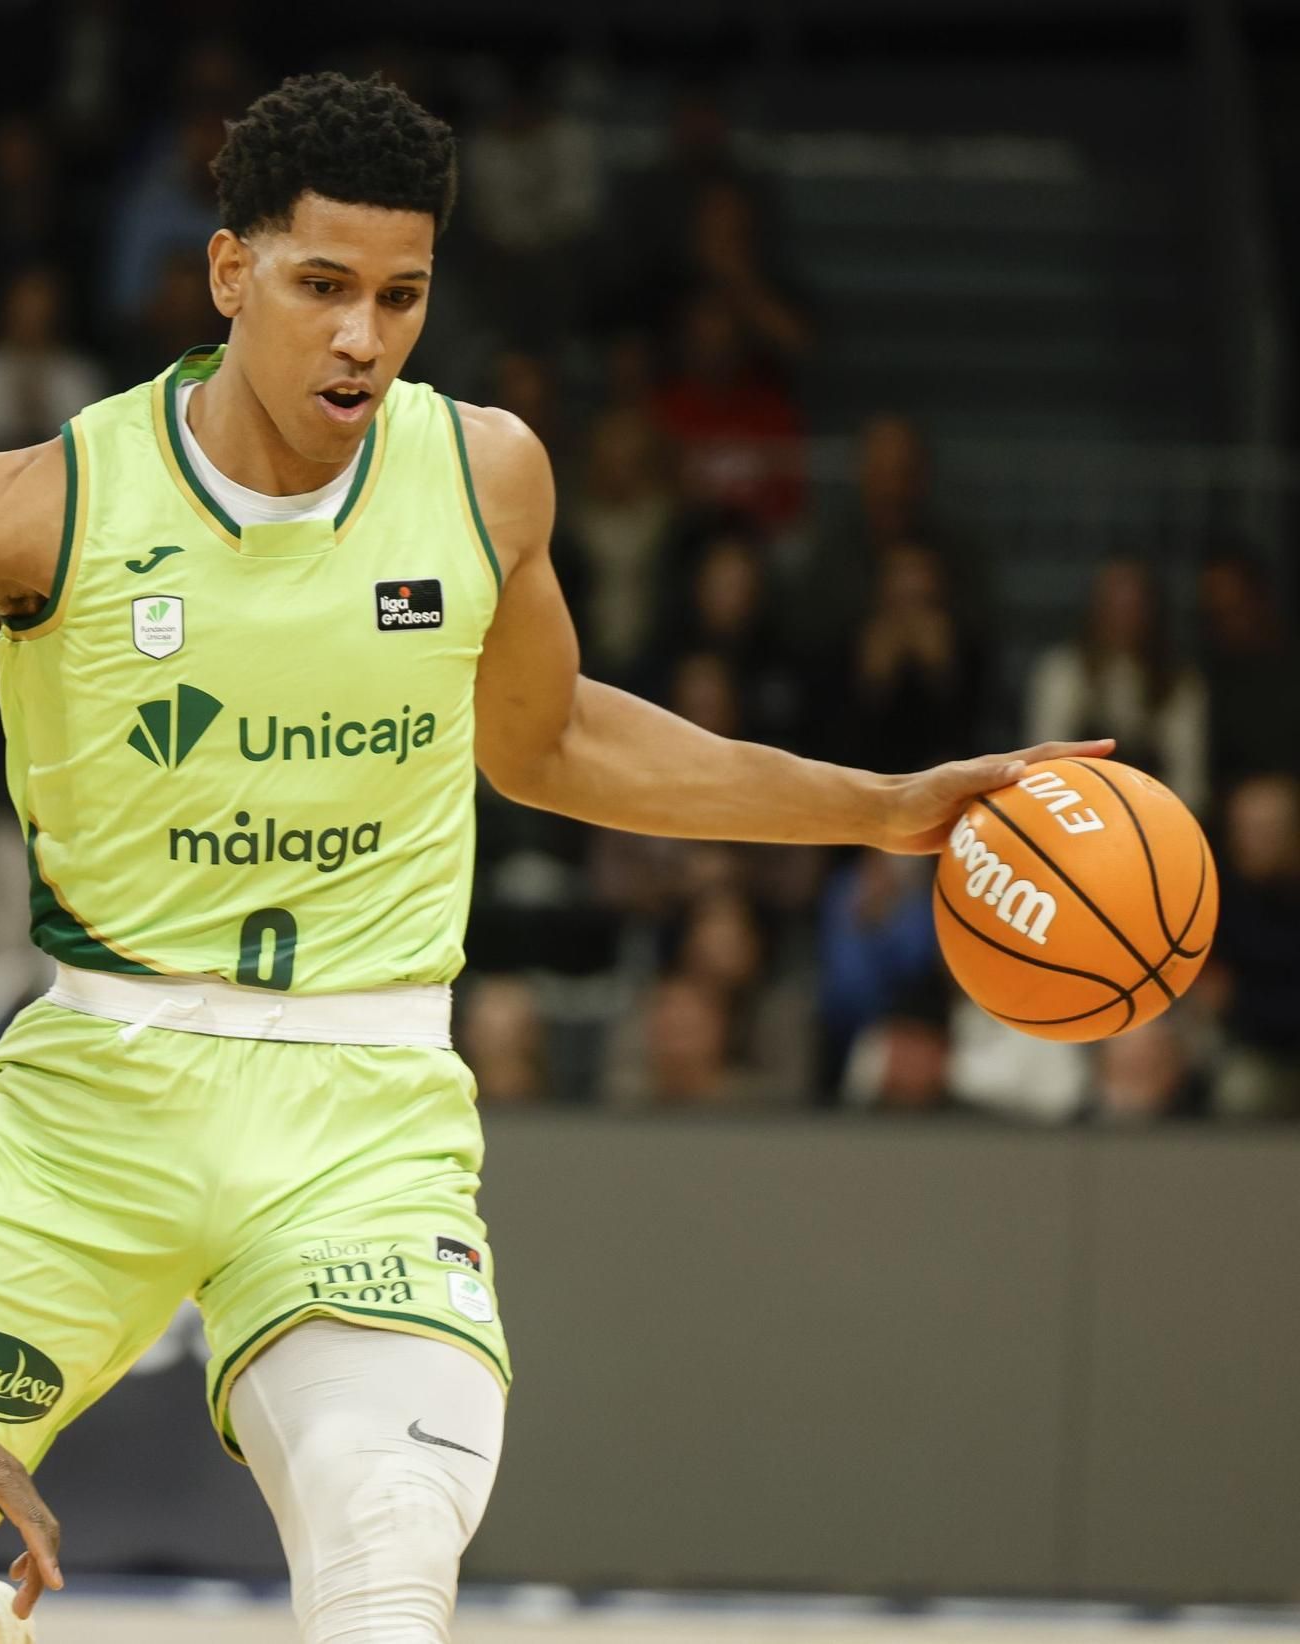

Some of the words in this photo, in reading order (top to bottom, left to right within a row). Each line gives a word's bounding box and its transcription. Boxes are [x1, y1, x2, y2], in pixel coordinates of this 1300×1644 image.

[380, 595, 409, 612] liga
[381, 609, 440, 625] endesa
[238, 705, 437, 765] Unicaja
[236, 907, 298, 992] 0
[300, 1240, 373, 1266] sabor
